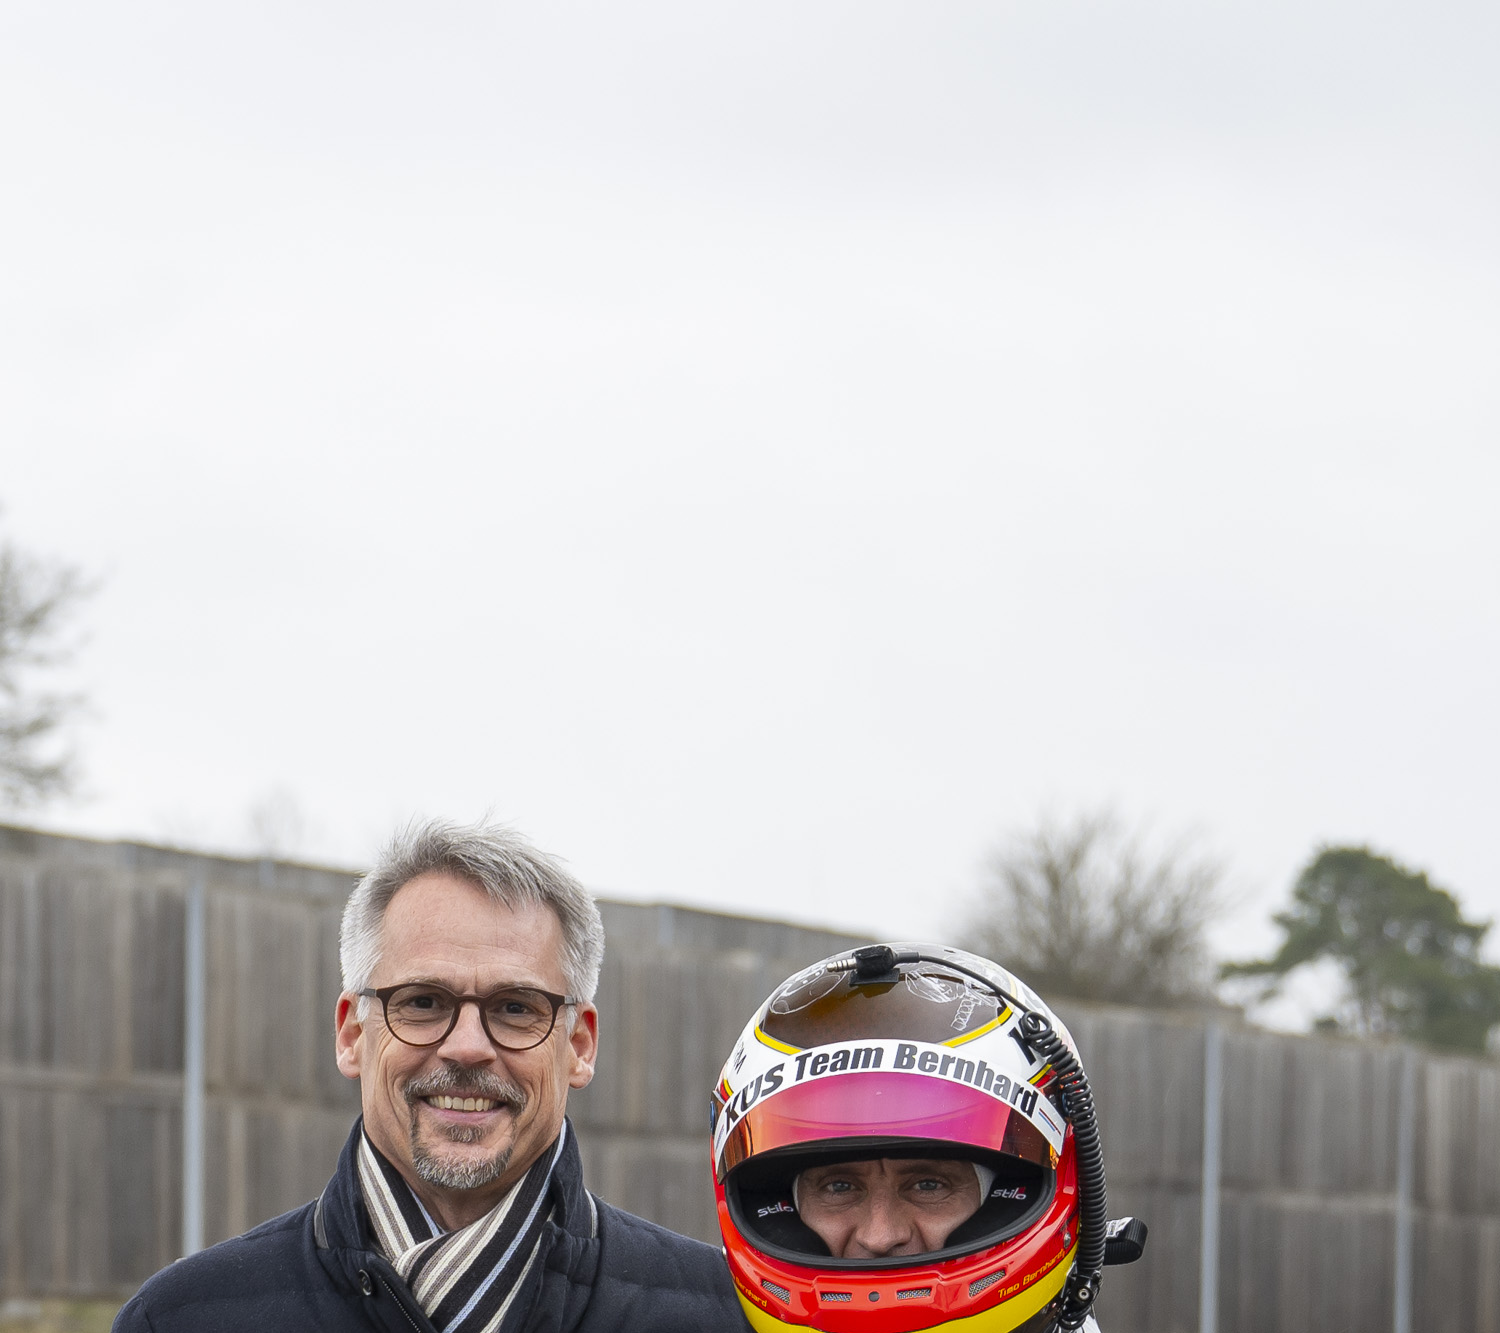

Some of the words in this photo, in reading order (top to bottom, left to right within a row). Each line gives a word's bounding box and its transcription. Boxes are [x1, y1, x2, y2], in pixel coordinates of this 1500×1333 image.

[724, 1063, 786, 1134] KÜS
[795, 1046, 884, 1082] Team
[893, 1043, 1039, 1118] Bernhard
[1023, 1248, 1066, 1286] Bernhard
